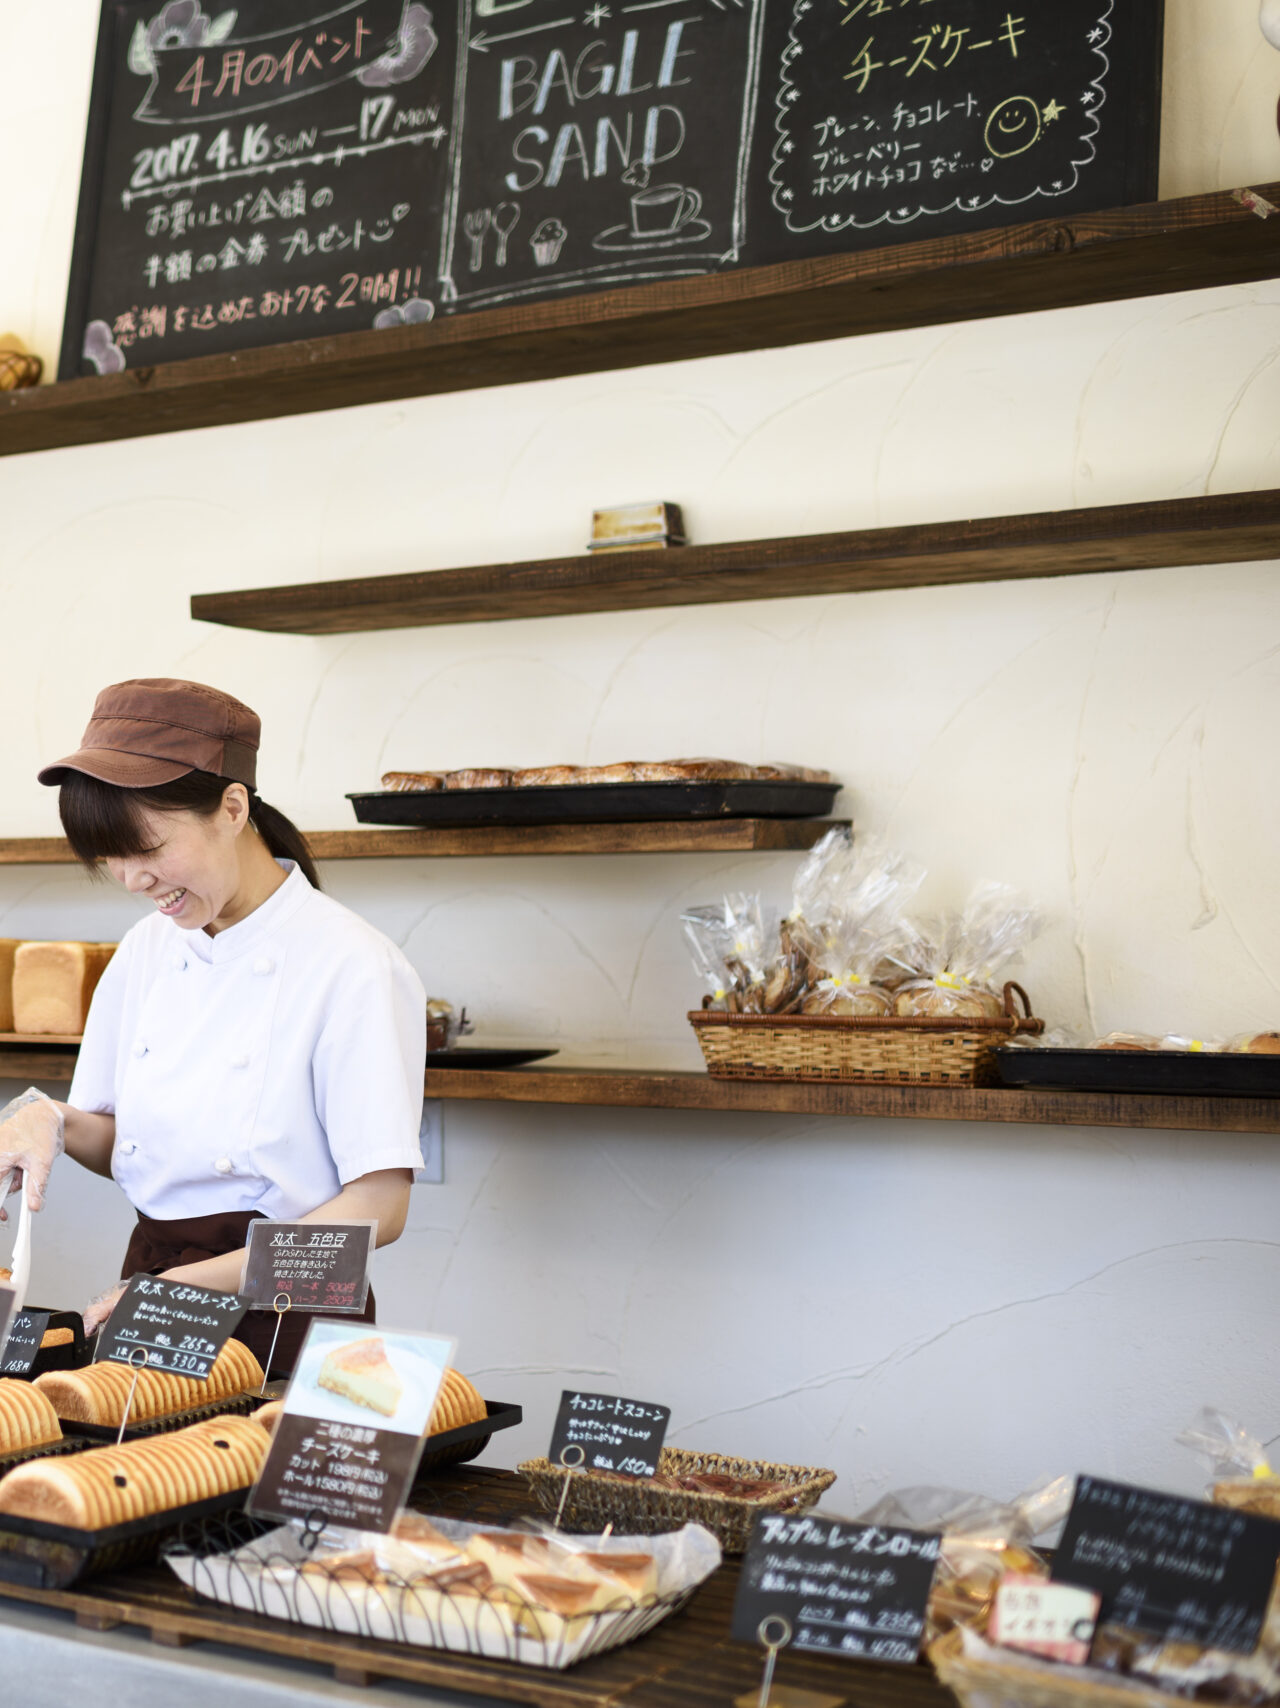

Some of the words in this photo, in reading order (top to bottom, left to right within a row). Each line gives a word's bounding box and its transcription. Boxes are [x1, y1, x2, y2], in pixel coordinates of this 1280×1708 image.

[175, 16, 372, 107] 4月のイベント
[498, 15, 704, 121] BAGLE
[842, 13, 1027, 94] チーズケーキ
[272, 127, 318, 159] SUN
[393, 104, 441, 132] MON
[505, 104, 686, 192] SAND
[812, 140, 922, 172] ブルーベリー
[269, 1231, 299, 1246] 丸太
[307, 1232, 349, 1247] 五色豆
[133, 1279, 165, 1297] 丸太
[168, 1286, 242, 1312] くるみレーズン
[179, 1334, 216, 1354] 265円
[4, 1359, 30, 1372] 168円
[171, 1353, 208, 1373] 530円
[569, 1394, 665, 1422] チョコレートスコーン
[288, 1454, 321, 1471] カット
[301, 1437, 381, 1466] チーズケーキ
[616, 1456, 655, 1477] 150円
